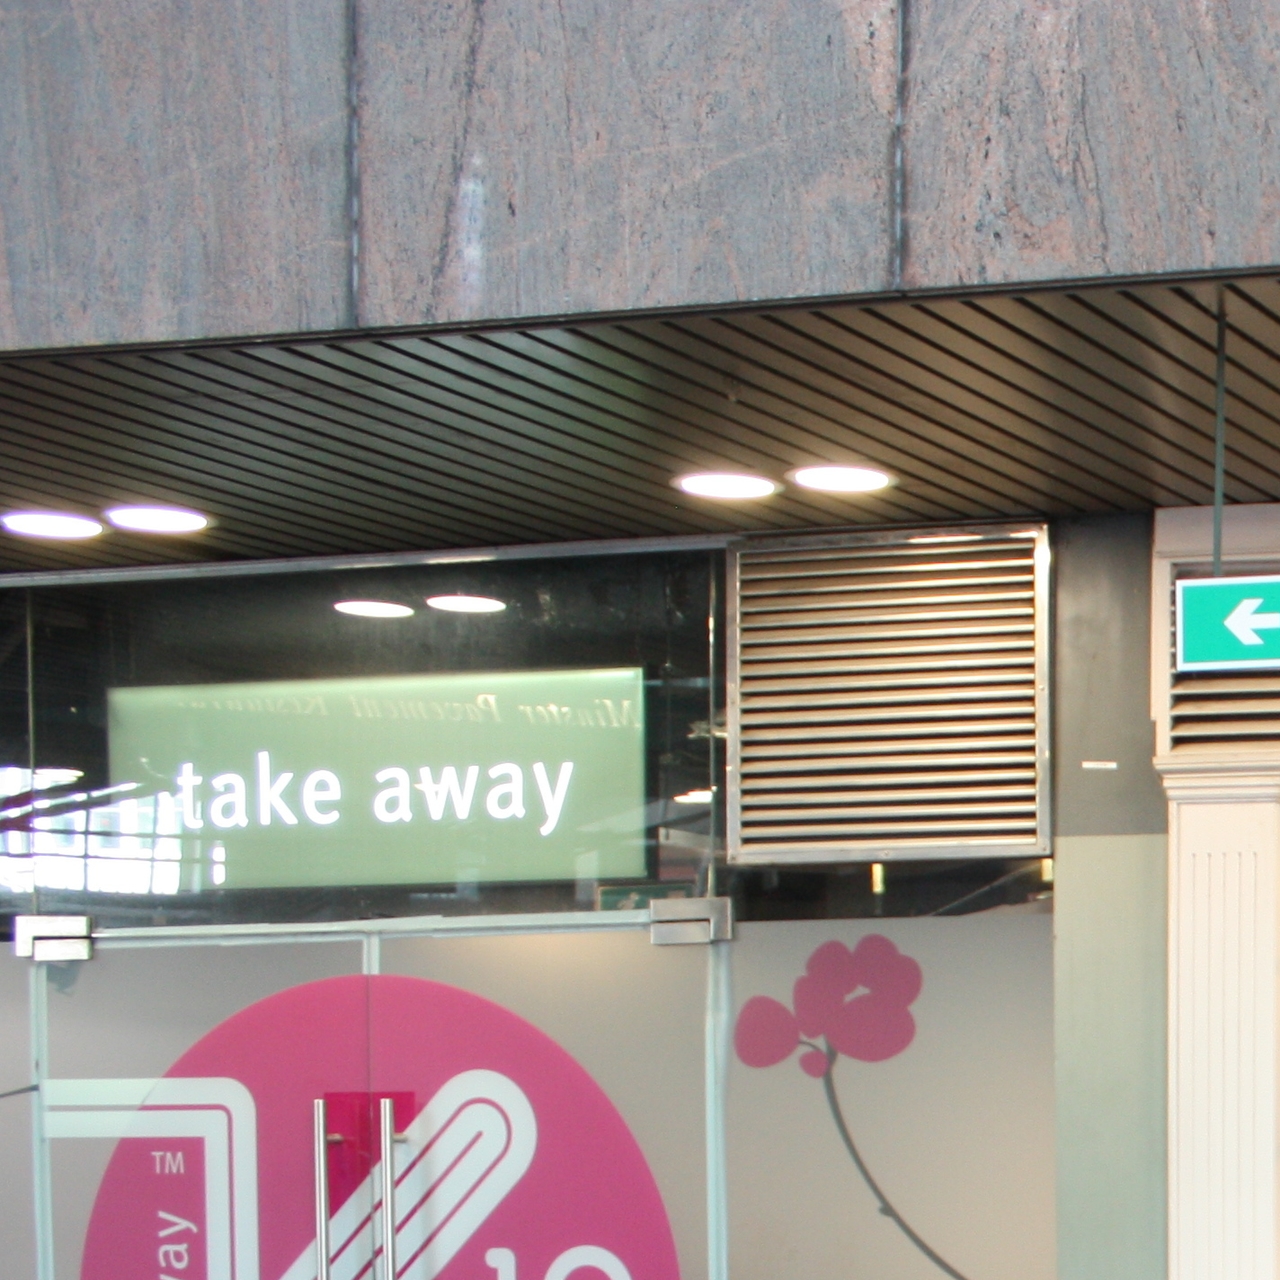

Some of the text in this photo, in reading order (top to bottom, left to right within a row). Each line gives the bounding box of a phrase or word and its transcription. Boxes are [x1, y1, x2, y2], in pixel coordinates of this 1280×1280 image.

[177, 750, 575, 837] take away
[151, 1150, 186, 1175] TM
